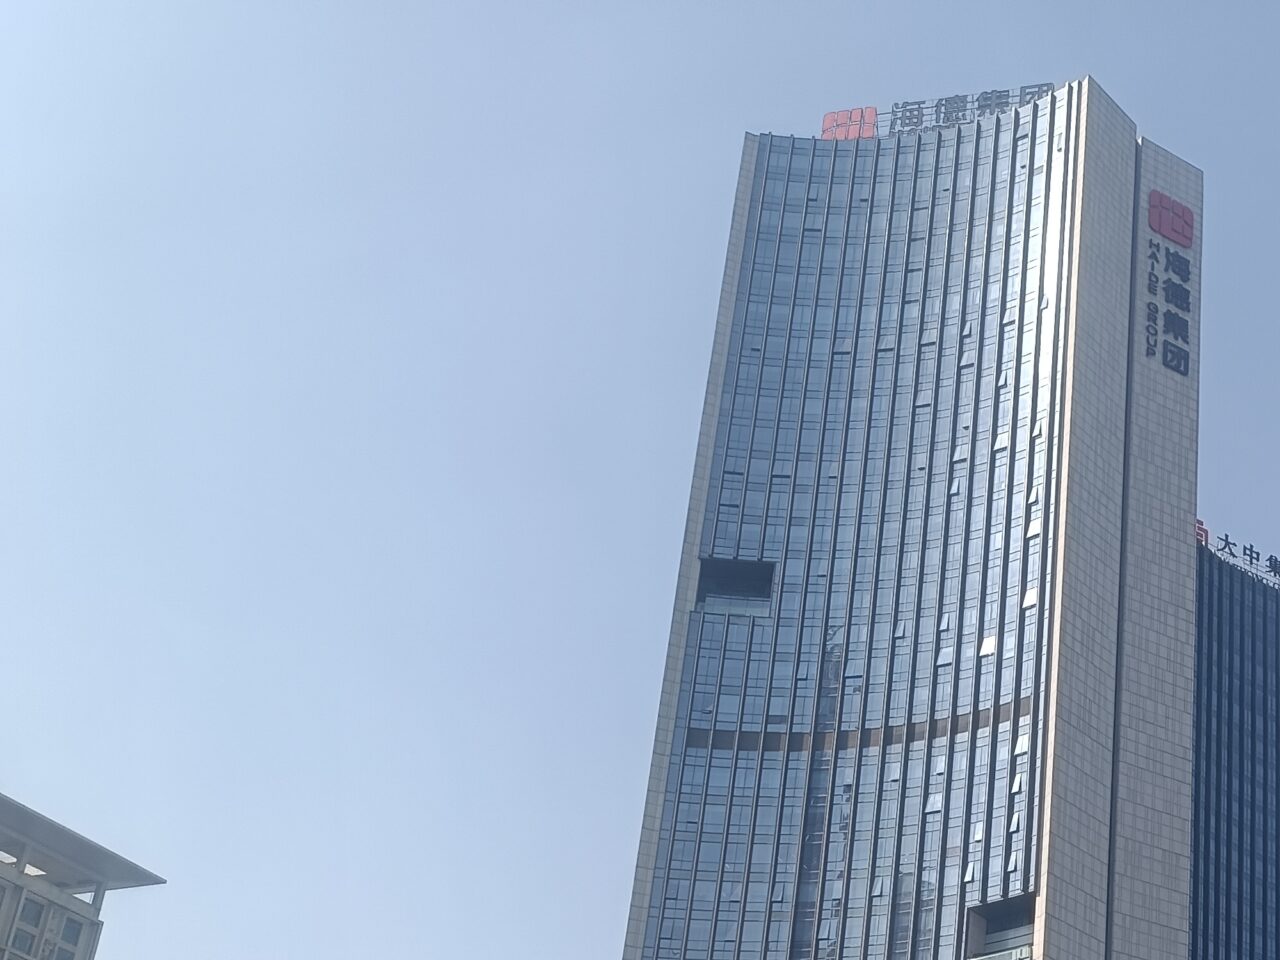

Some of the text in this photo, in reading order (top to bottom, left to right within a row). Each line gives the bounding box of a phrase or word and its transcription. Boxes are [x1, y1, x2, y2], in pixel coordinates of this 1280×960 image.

[1145, 238, 1161, 358] HAIDE GROUP
[1162, 246, 1191, 377] 海德集团
